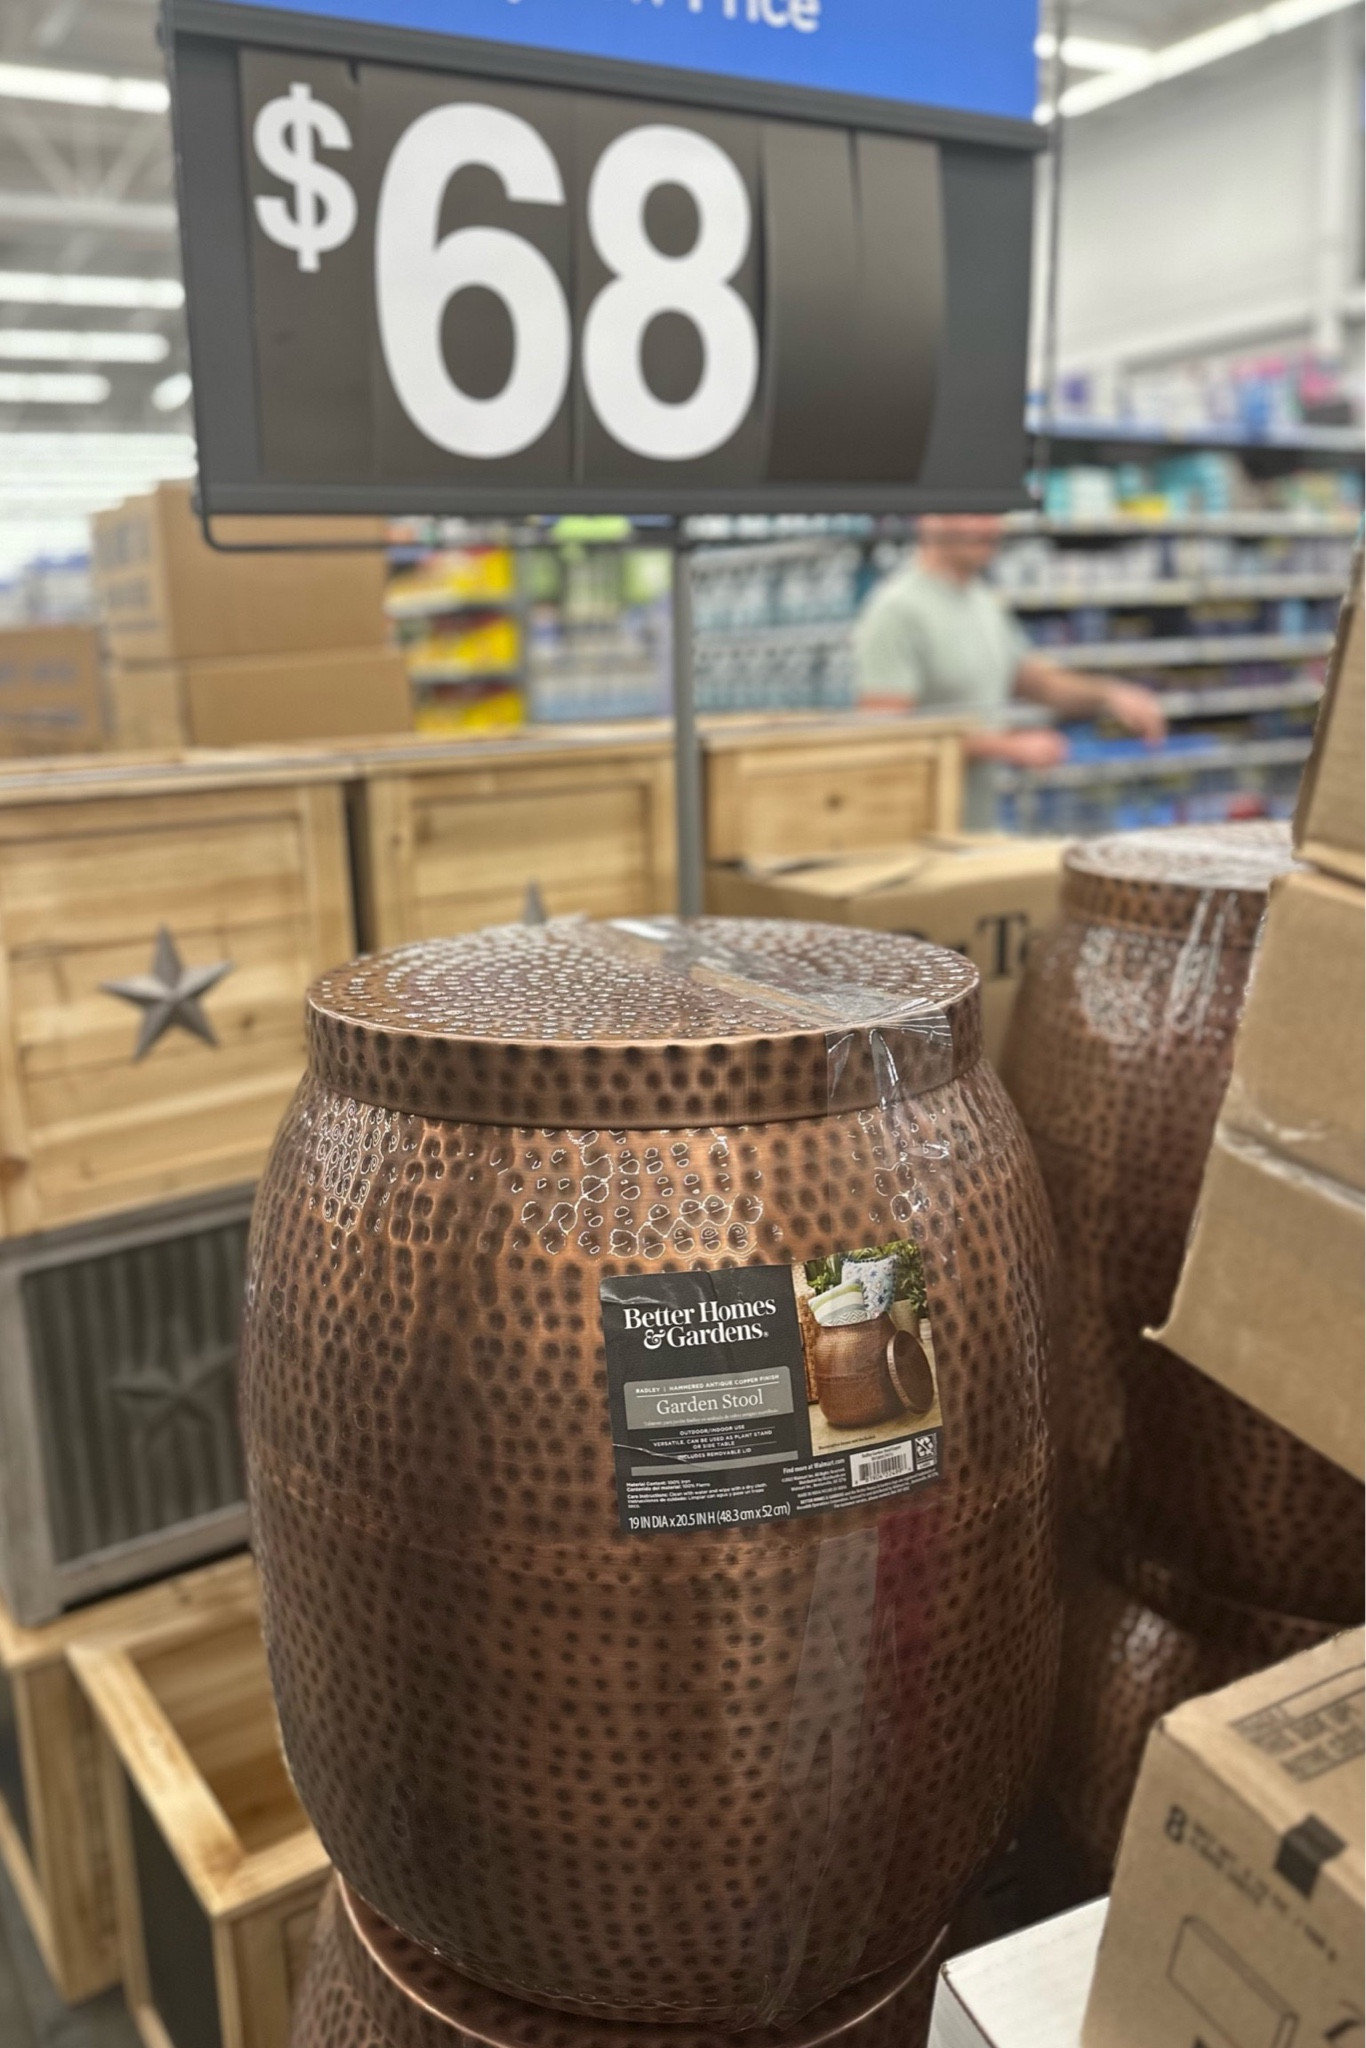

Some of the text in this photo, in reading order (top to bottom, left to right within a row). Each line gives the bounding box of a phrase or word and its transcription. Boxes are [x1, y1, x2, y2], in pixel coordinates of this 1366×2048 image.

[253, 82, 760, 461] $68
[623, 1299, 776, 1329] Better Homes
[669, 1383, 705, 1391] HAMMERED
[705, 1380, 733, 1388] ANTIQUE
[734, 1377, 758, 1385] COPPER
[656, 1388, 764, 1415] Garden Stool
[680, 1426, 732, 1436] OUTDOOR/INDOOR
[706, 1449, 741, 1457] REMOVABLE
[628, 1502, 791, 1529] 19 IN DIA x 20.5 IN H (48.3 cm x 52 cm)
